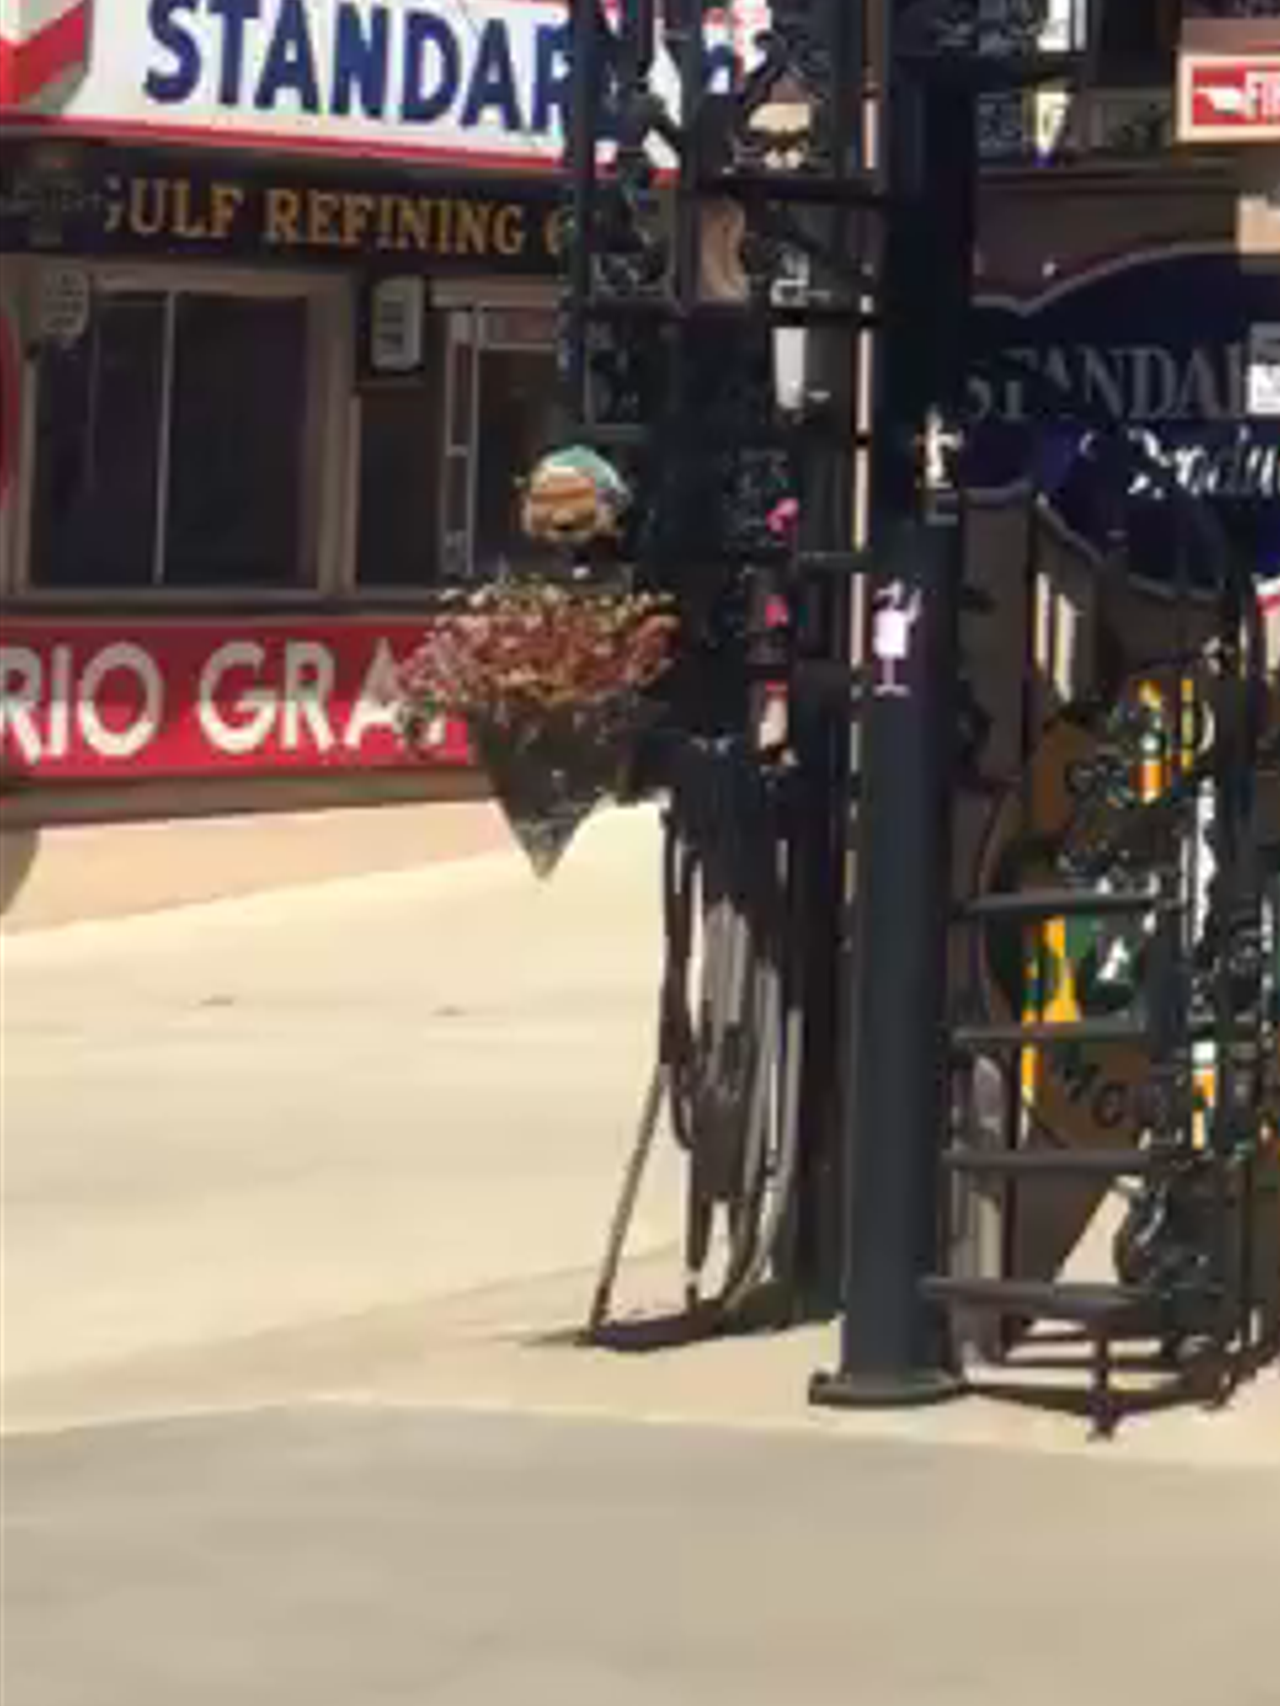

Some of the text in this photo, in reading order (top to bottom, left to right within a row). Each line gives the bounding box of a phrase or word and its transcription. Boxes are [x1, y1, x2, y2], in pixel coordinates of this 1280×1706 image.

[265, 188, 526, 255] REFINING
[0, 637, 446, 764] RIO GRA
